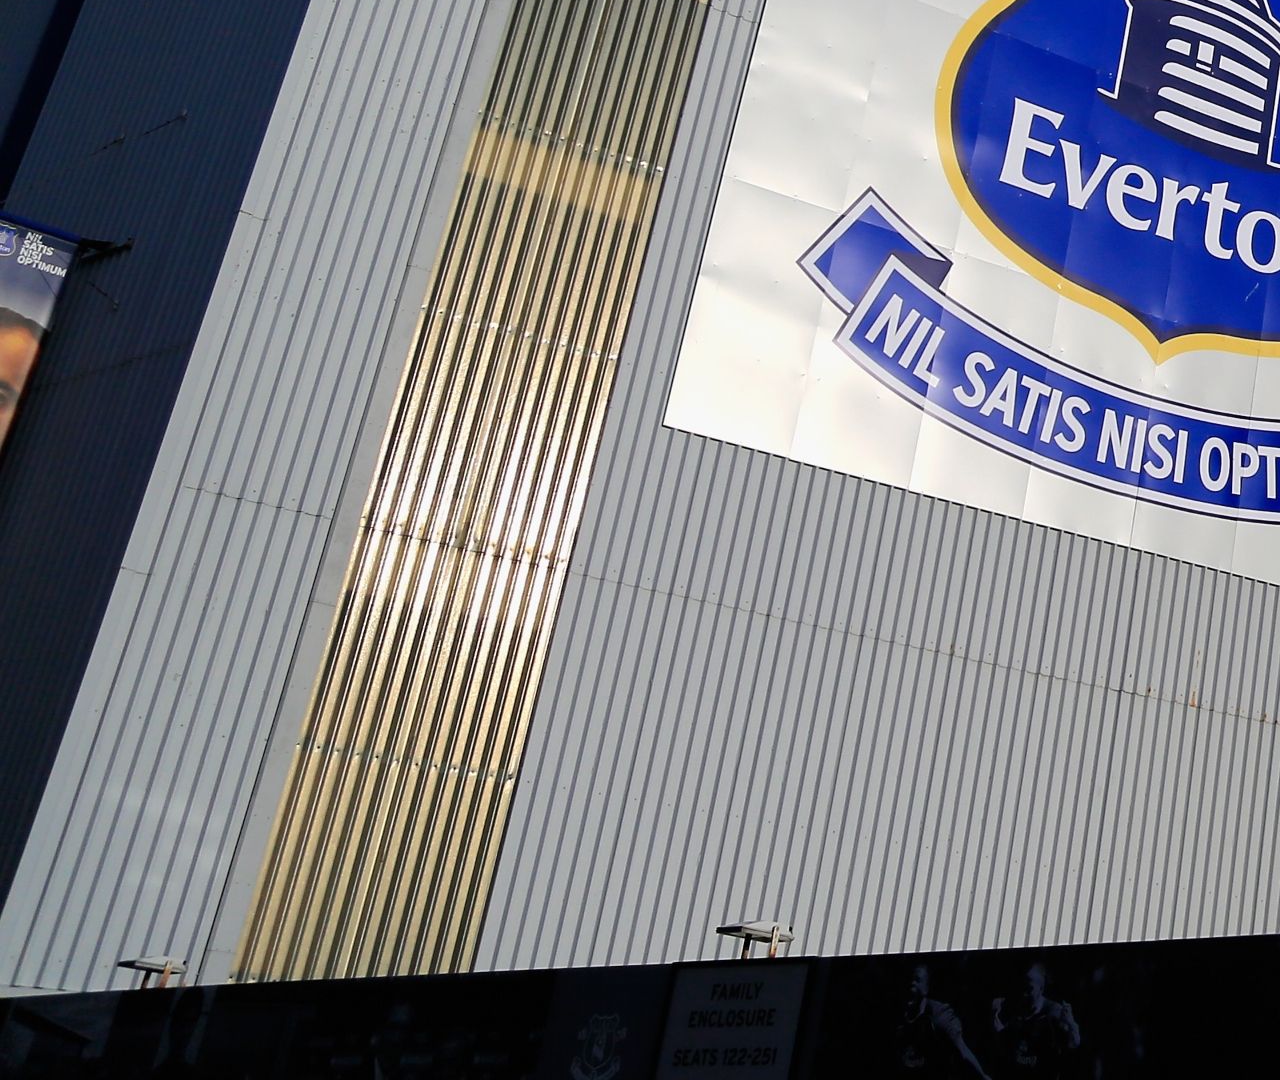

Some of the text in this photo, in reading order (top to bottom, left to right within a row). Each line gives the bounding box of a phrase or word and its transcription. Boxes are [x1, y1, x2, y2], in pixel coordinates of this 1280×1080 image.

[22, 239, 55, 257] SATIS
[24, 231, 43, 245] NIL
[19, 247, 43, 261] NISI
[16, 255, 68, 278] OPTIMUM
[864, 293, 946, 388] NIL
[952, 350, 1089, 454] SATIS
[1099, 406, 1189, 485] NISI
[709, 981, 765, 1001] FAMILY
[687, 1008, 777, 1029] ENCLOSURE
[671, 1047, 719, 1068] SEATS
